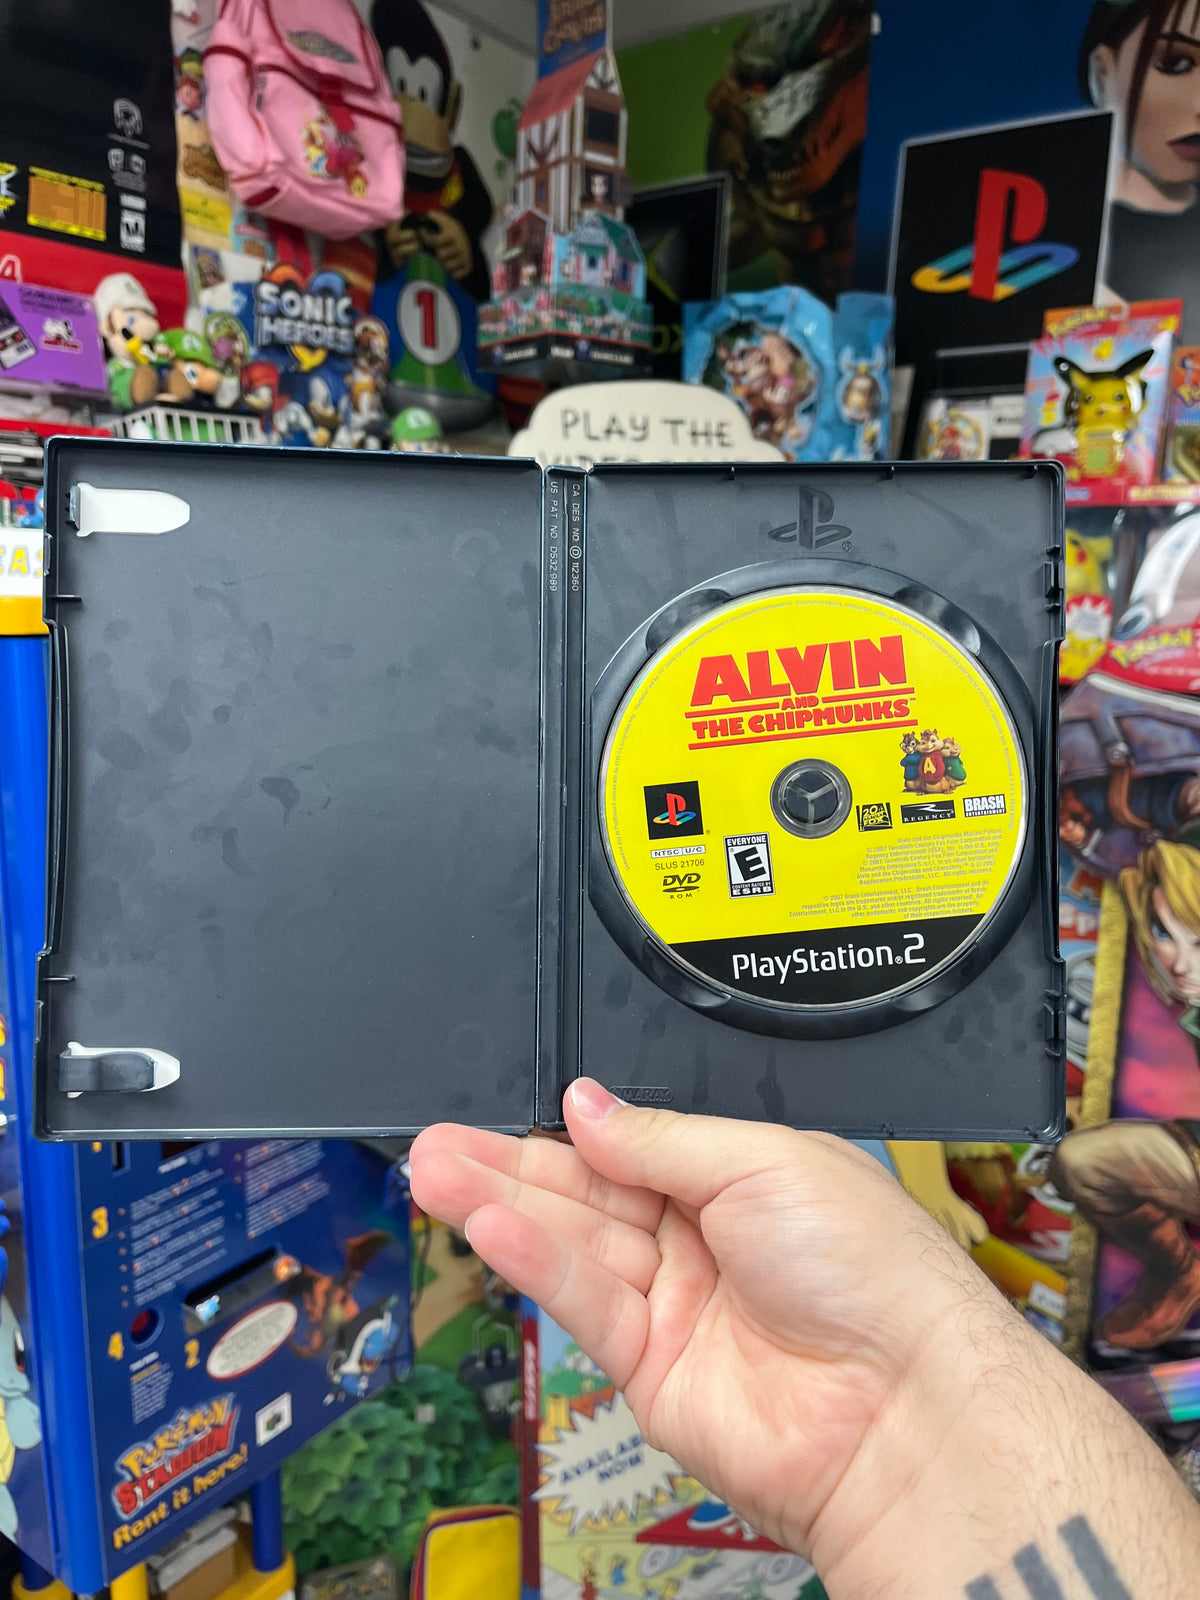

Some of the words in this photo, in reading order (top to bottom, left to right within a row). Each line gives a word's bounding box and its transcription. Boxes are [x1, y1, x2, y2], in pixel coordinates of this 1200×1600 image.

[259, 282, 352, 325] SONIC
[416, 289, 436, 349] 1
[259, 317, 353, 353] HEROES
[560, 408, 649, 442] PLAY
[662, 419, 735, 448] THE
[550, 481, 558, 494] US
[550, 499, 558, 518] PAT
[572, 503, 580, 522] DES
[690, 634, 907, 707] ALVIN
[781, 695, 819, 711] AND
[692, 717, 745, 740] THE
[748, 699, 910, 734] CHIPMUNKS
[924, 757, 937, 775] A
[964, 795, 1005, 812] BRASH
[654, 849, 680, 857] NTSC
[685, 846, 703, 854] U/C
[727, 835, 767, 847] EVERYONE
[655, 861, 679, 871] SLUS
[680, 859, 705, 868] 21706
[733, 846, 767, 882] E
[662, 873, 701, 887] DVD
[732, 886, 772, 895] ESRB
[91, 1206, 109, 1239] 3
[184, 1338, 200, 1369] 2
[598, 1453, 643, 1482] NOW
[113, 1502, 168, 1550] Rent
[173, 1487, 190, 1510] it
[193, 1443, 248, 1494] here!
